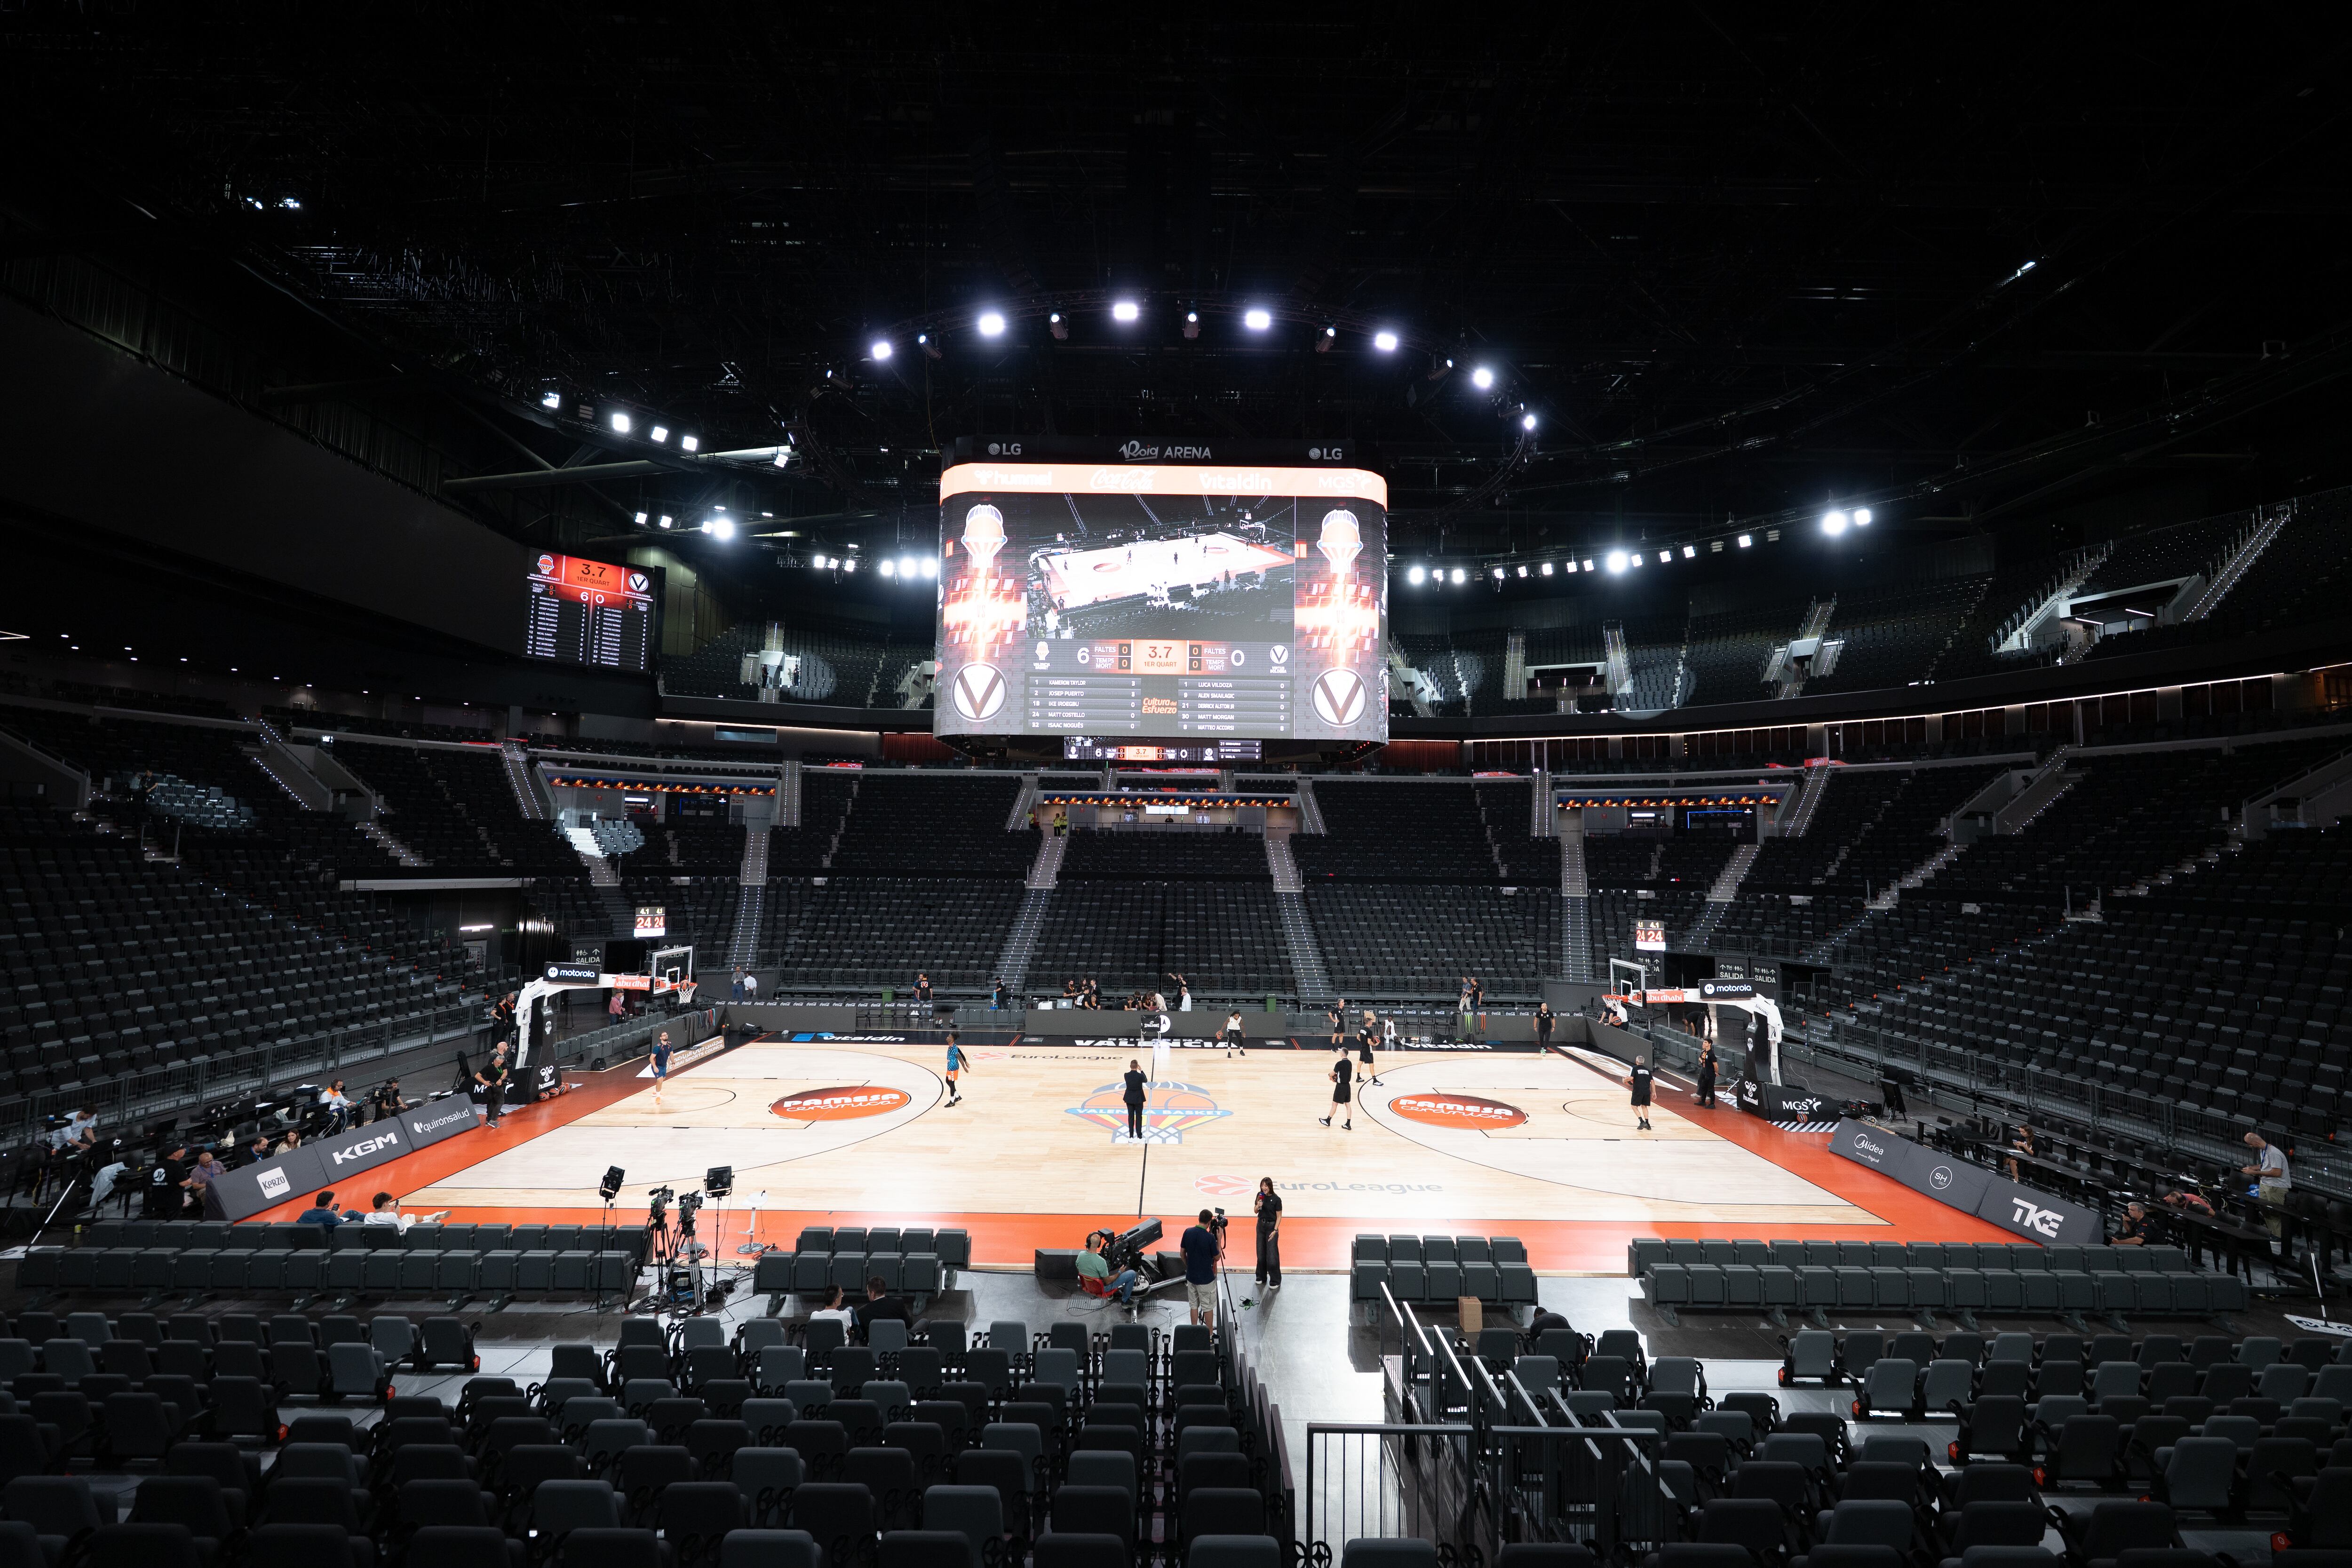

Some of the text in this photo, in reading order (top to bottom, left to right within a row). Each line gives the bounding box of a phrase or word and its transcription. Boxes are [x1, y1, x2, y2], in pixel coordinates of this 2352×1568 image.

[1002, 443, 1021, 455] LG
[1119, 440, 1211, 461] Roig ARENA
[1323, 448, 1342, 460] LG
[994, 471, 1052, 486] hummel
[1090, 469, 1157, 490] Coca-Cola
[1199, 473, 1271, 490] vitaldin
[1319, 476, 1354, 489] MGS
[581, 564, 606, 578] 3.7
[580, 591, 588, 601] 6
[595, 594, 604, 604] 0
[1077, 647, 1090, 664] 6
[1148, 646, 1172, 659] 3.7
[1231, 650, 1245, 667] 0
[1142, 705, 1177, 714] Esfuerzo
[1095, 748, 1102, 757] 6
[1180, 749, 1187, 758] 0
[636, 917, 652, 928] 24
[654, 916, 664, 928] 24
[1637, 930, 1645, 941] 24
[1647, 931, 1663, 942] 24
[560, 969, 595, 978] motorola
[1755, 975, 1776, 984] SALIDA
[685, 1052, 704, 1062] SPORTS
[705, 1044, 723, 1054] COUNCIL
[539, 1078, 555, 1090] hummel
[783, 1094, 900, 1107] PAMESA
[1743, 1094, 1758, 1106] hummel
[1782, 1101, 1809, 1110] MGS
[1399, 1098, 1514, 1116] PAMESA
[424, 1107, 470, 1133] quirónsalud
[332, 1132, 397, 1165] KGM
[1858, 1140, 1884, 1155] Midea
[1934, 1172, 1947, 1182] SH
[1271, 1181, 1443, 1194] EuroLeague
[2012, 1197, 2064, 1238] TKE
